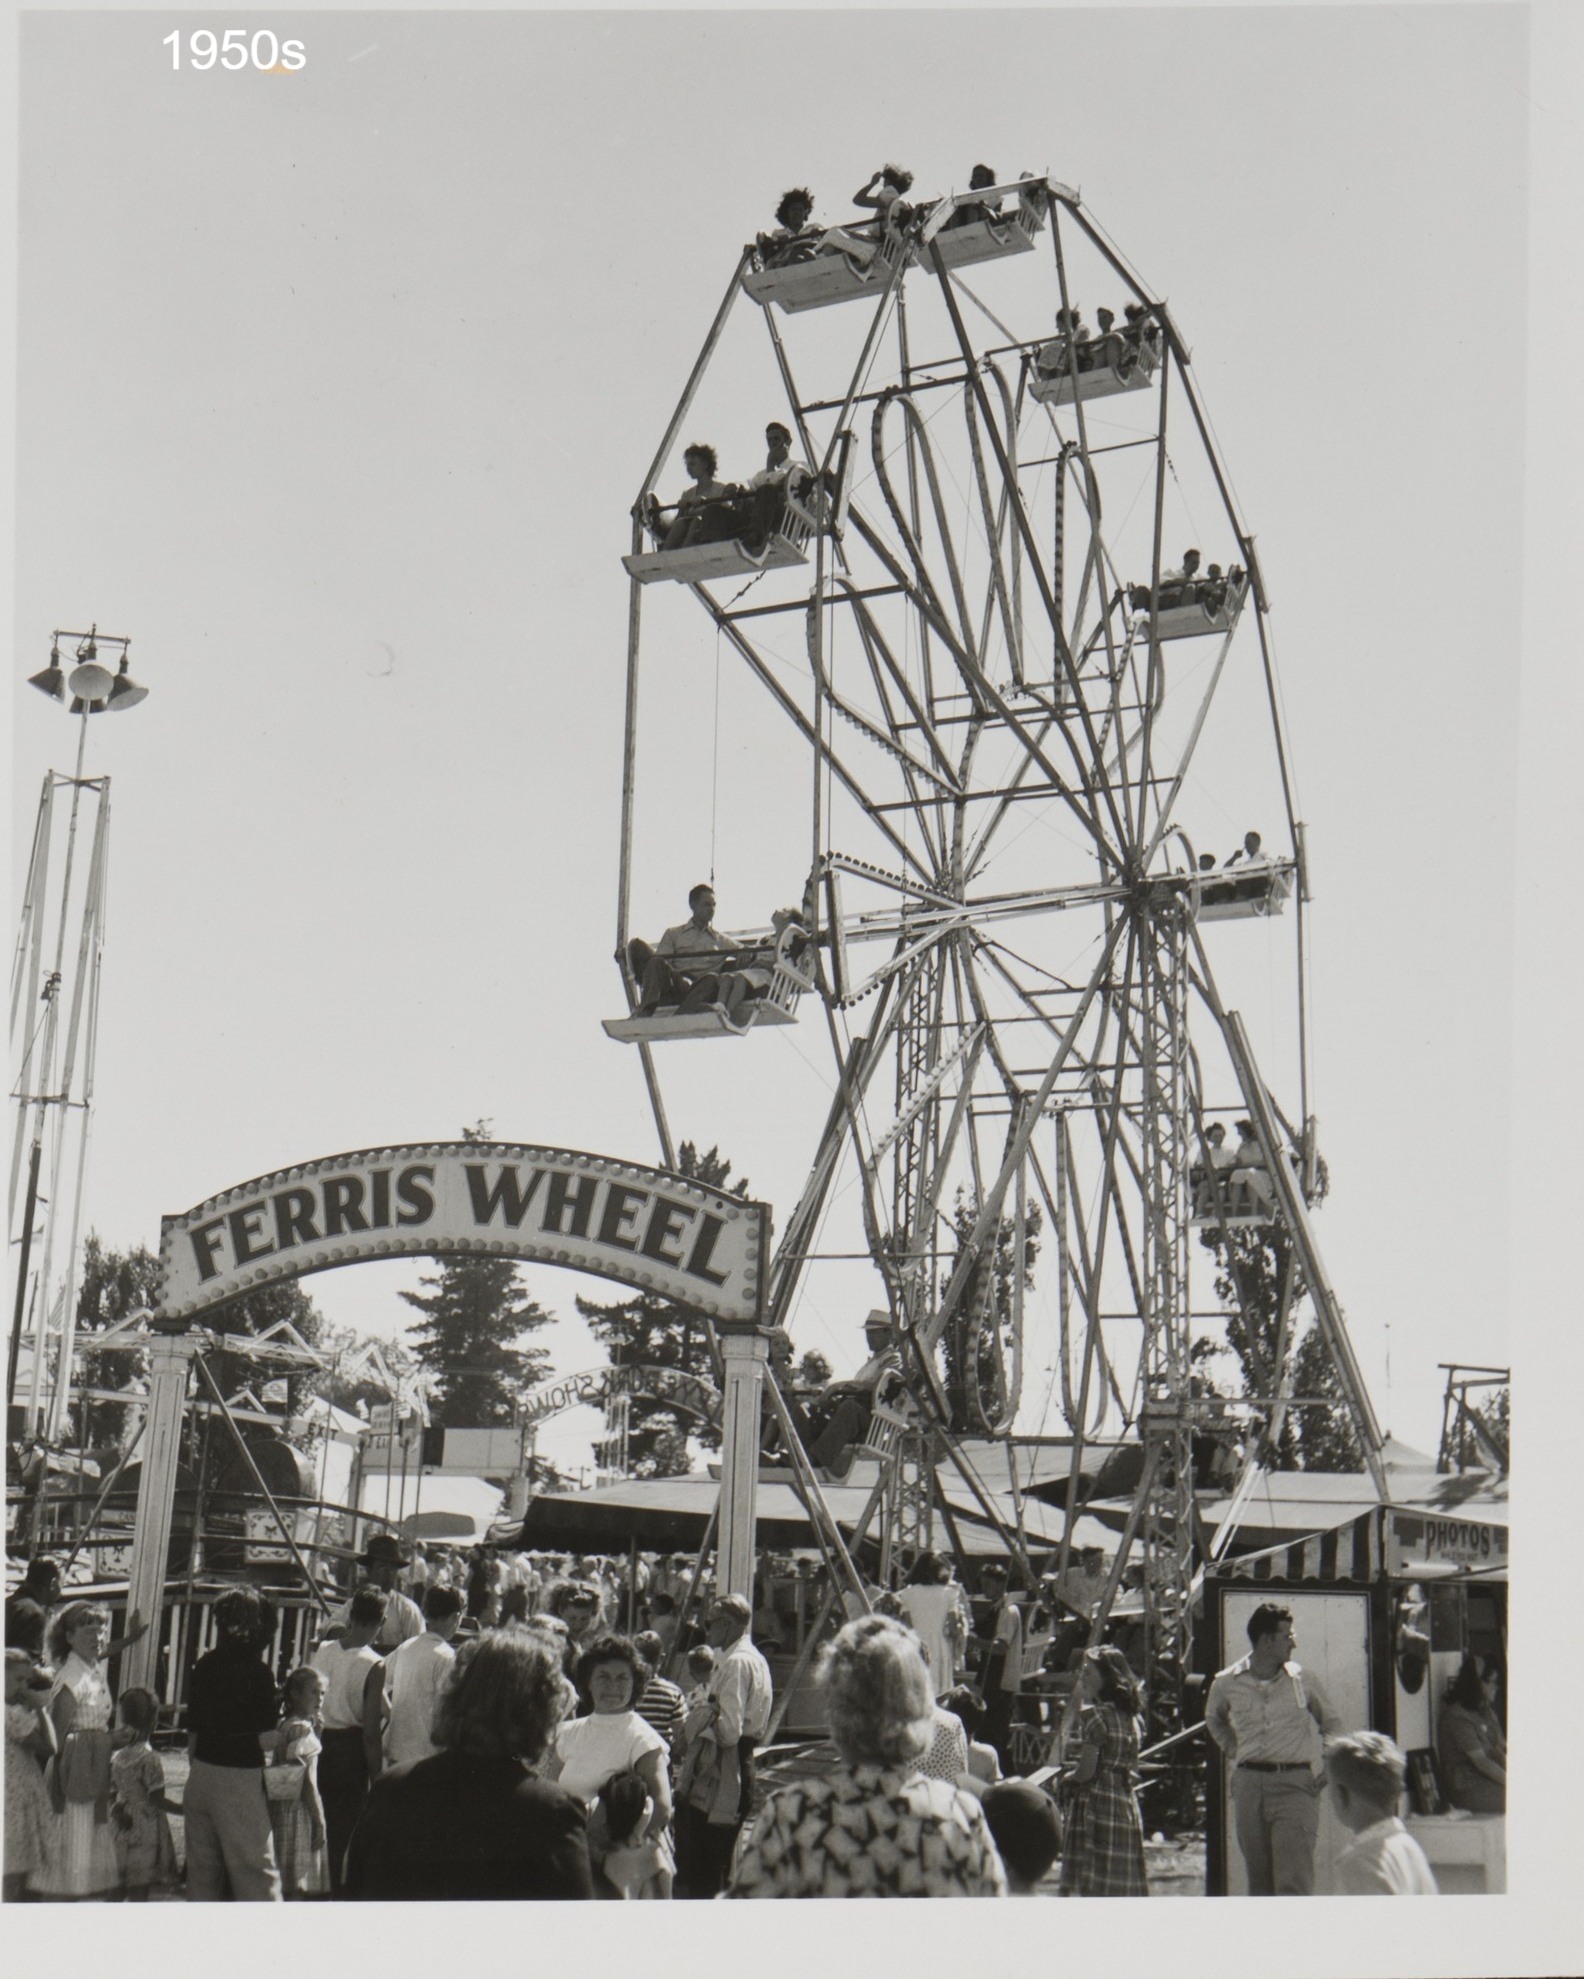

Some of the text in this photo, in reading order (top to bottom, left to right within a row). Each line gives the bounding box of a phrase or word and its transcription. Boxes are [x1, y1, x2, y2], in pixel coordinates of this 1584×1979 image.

[189, 1162, 732, 1288] FERRIS WHEEL
[308, 1421, 339, 1440] EXT
[1425, 1520, 1490, 1561] PHOTOS
